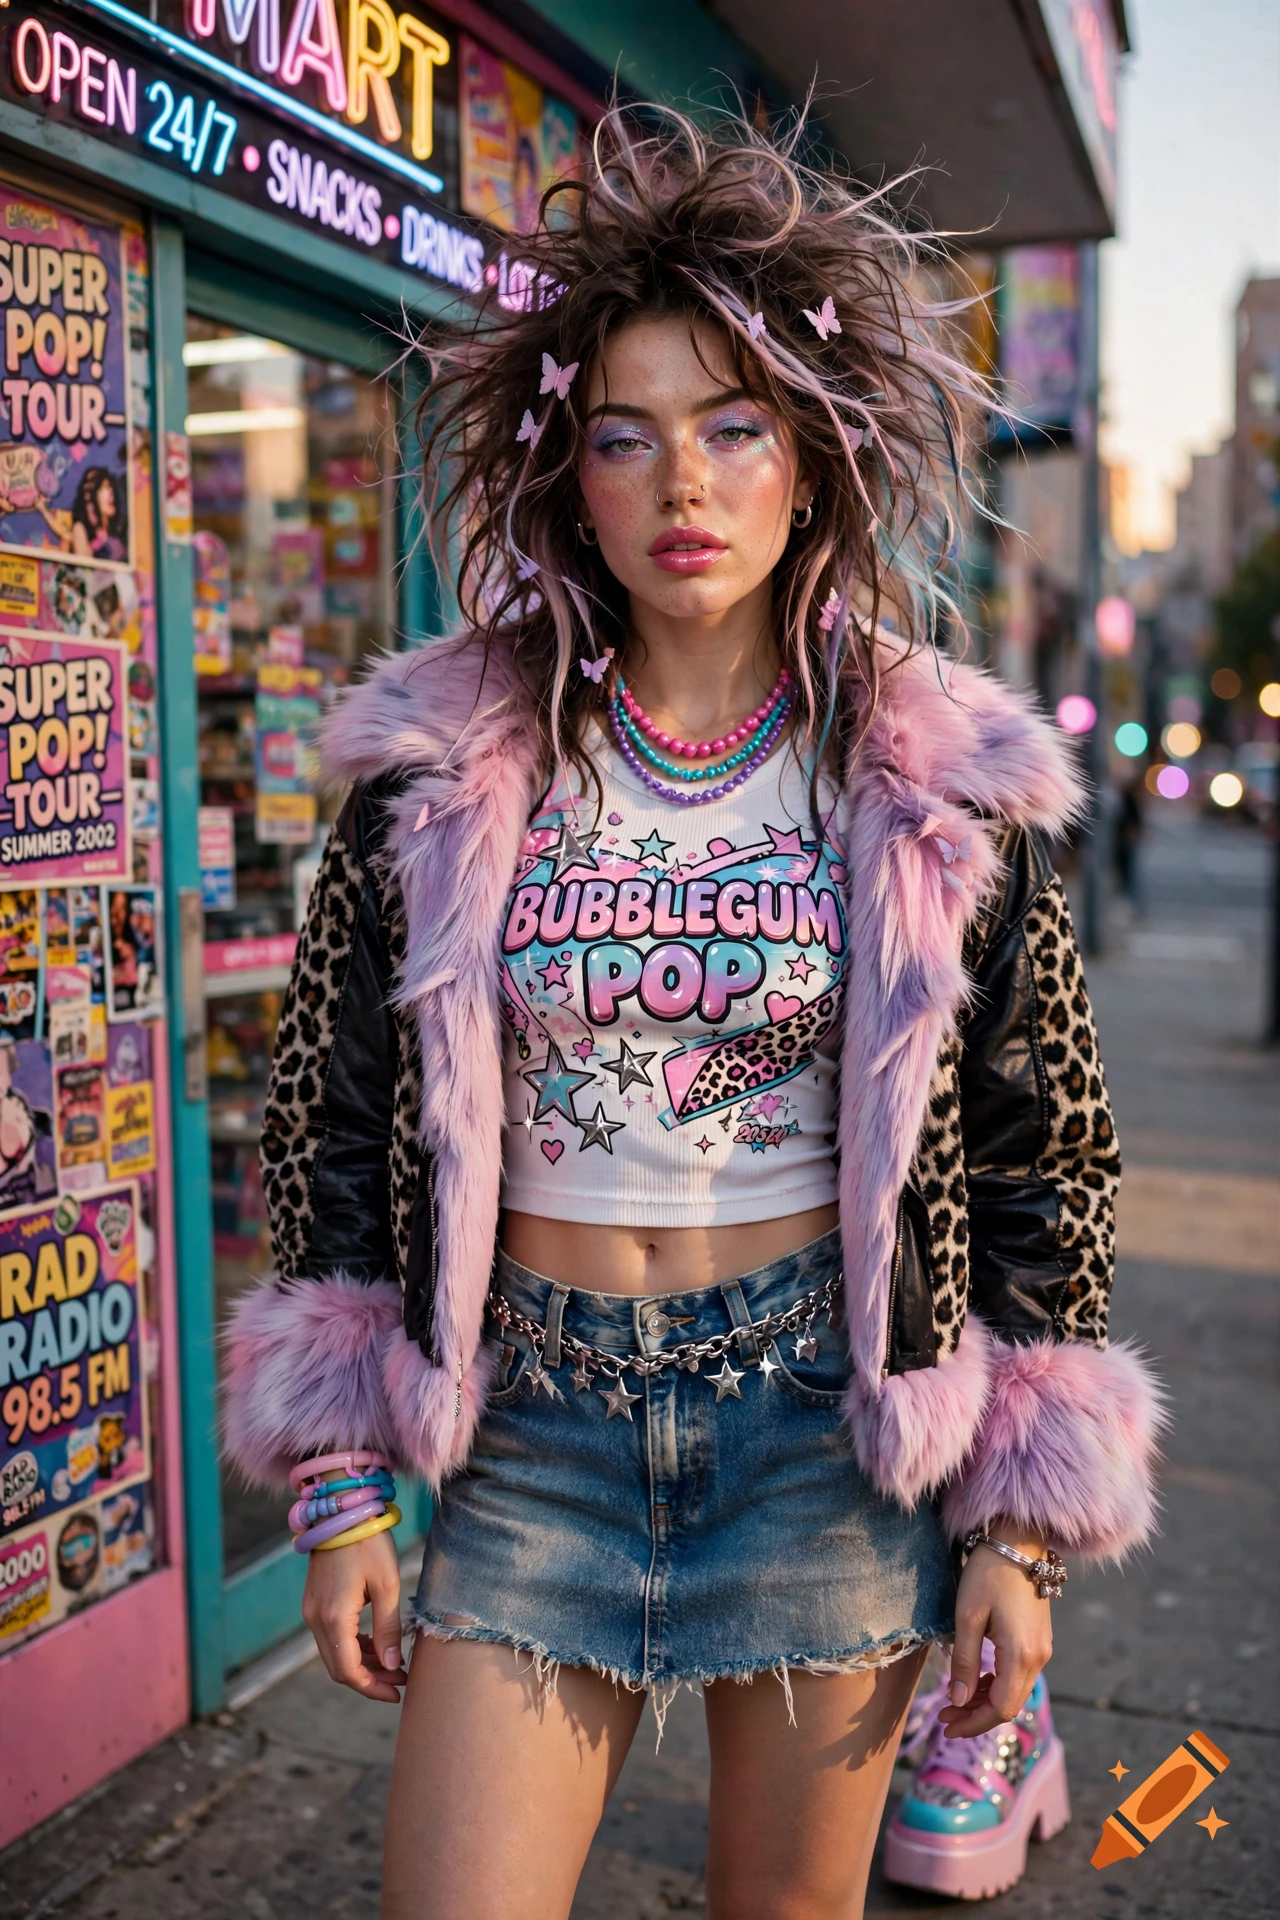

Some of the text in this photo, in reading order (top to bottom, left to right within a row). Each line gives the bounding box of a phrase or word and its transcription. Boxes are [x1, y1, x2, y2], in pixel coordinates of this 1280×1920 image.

[16, 18, 137, 134] OPEN
[147, 80, 238, 175] 24/7
[266, 139, 383, 247] SNACKS
[402, 204, 485, 294] DRINKS
[5, 308, 107, 380] POP!
[0, 658, 113, 724] SUPER
[9, 713, 109, 781] POP!
[1, 822, 116, 863] SUMMER 2002
[501, 878, 847, 954] BUBBLEGUM
[582, 939, 766, 1026] POP
[0, 1233, 99, 1320] RAD
[0, 1282, 132, 1388] RADIO
[3, 1343, 130, 1444] 98.5 FM
